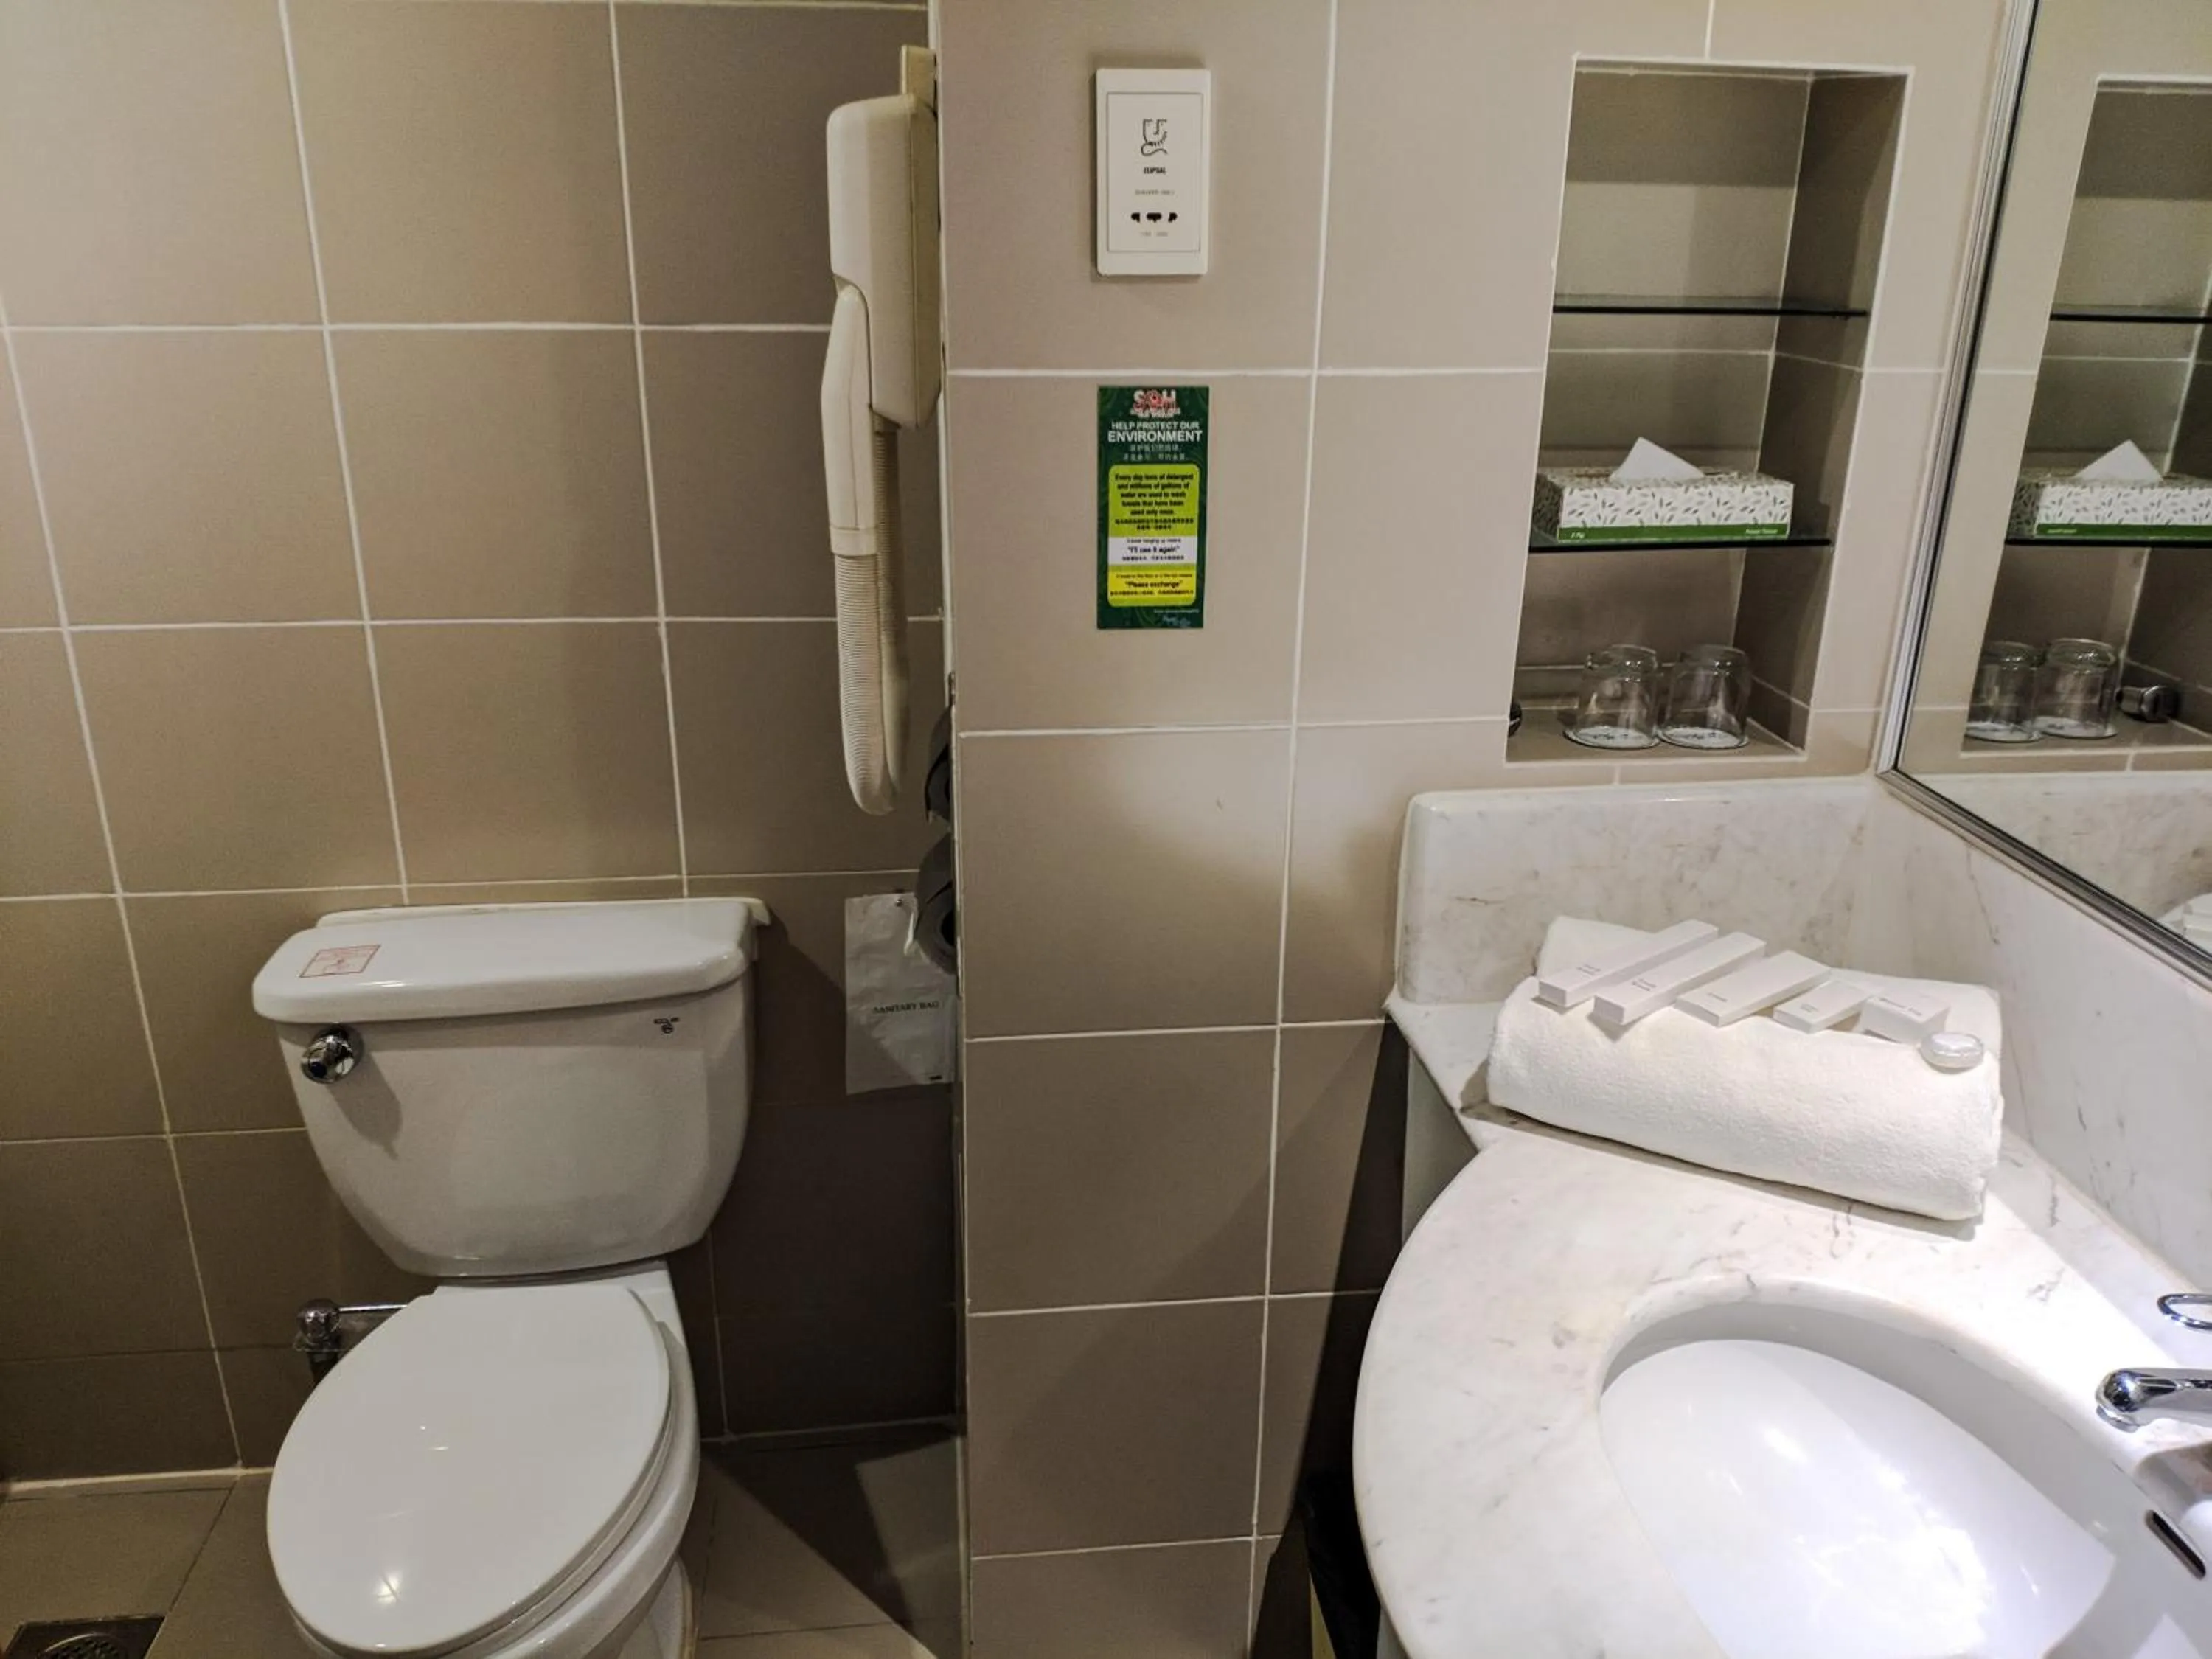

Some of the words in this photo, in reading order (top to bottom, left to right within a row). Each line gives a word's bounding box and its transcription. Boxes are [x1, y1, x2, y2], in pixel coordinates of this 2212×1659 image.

[1111, 421, 1135, 430] HELP
[1136, 421, 1179, 430] PROTECT
[1180, 421, 1200, 430] OUR
[1107, 430, 1203, 442] ENVIRONMENT
[872, 1003, 917, 1014] SANITARY
[919, 1000, 939, 1009] BAG
